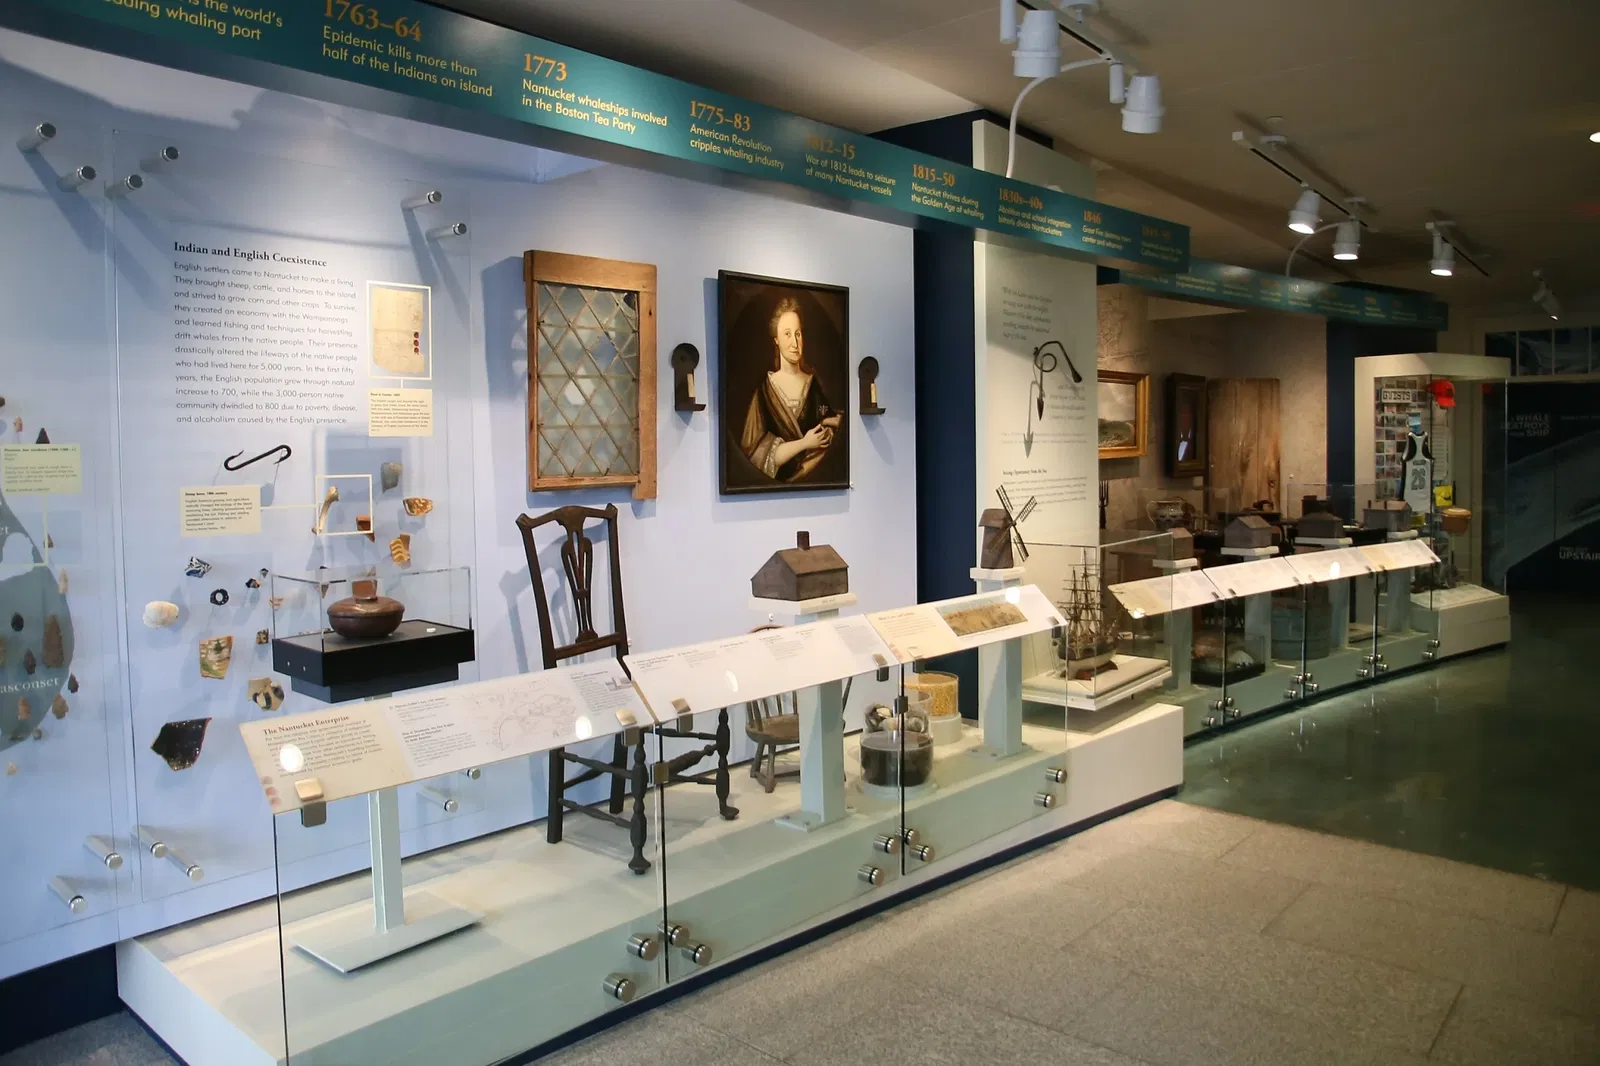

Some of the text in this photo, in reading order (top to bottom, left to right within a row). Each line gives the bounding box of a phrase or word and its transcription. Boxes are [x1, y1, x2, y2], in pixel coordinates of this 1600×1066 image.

[166, 7, 226, 35] whaling
[232, 24, 262, 40] port
[205, 0, 283, 28] the world's
[323, 26, 477, 76] Epidemic kills more than
[322, 44, 493, 97] half of the Indians on island
[524, 53, 568, 81] 1773
[522, 78, 667, 126] Nantucket whaleships involved
[522, 95, 636, 135] in the Boston Tea Party
[690, 123, 772, 152] American Revolution
[690, 139, 785, 171] cripples whaling industry
[805, 153, 819, 165] War
[830, 160, 847, 173] 1812
[848, 165, 865, 178] leads
[866, 171, 873, 180] to
[874, 174, 896, 186] seizure
[805, 167, 892, 196] of many Nantucket vessels
[911, 182, 979, 208] Nantucket thrives during
[911, 194, 921, 203] the
[922, 196, 942, 208] Golden
[944, 202, 955, 212] Age
[963, 207, 985, 220] whaling
[174, 242, 327, 267] Indian and English Coexistence
[174, 262, 202, 272] English
[204, 266, 230, 274] settlers
[263, 271, 300, 280] Nantucket
[174, 275, 193, 285] They
[195, 278, 225, 288] brought
[227, 281, 251, 290] sheep,
[253, 284, 275, 292] cattle,
[293, 286, 314, 294] horses
[174, 304, 192, 313] they
[236, 310, 270, 318] economy
[192, 292, 216, 300] strived
[333, 304, 357, 312] survive,
[192, 319, 222, 327] learned
[224, 321, 248, 330] fishing
[267, 325, 305, 333] techniques
[318, 328, 353, 337] harvesting
[193, 333, 220, 341] whales
[222, 334, 239, 342] from
[174, 346, 215, 356] drastically
[217, 348, 244, 356] altered
[194, 360, 209, 368] had
[260, 363, 282, 371] 5,000
[215, 375, 242, 383] English
[244, 376, 283, 384] population
[303, 378, 330, 386] through
[221, 388, 238, 396] 700,
[220, 402, 254, 410] dwindled
[1383, 390, 1411, 400] GUESTS
[266, 416, 274, 424] by
[290, 416, 314, 424] English
[262, 715, 350, 736] The Nantucket Enterprise
